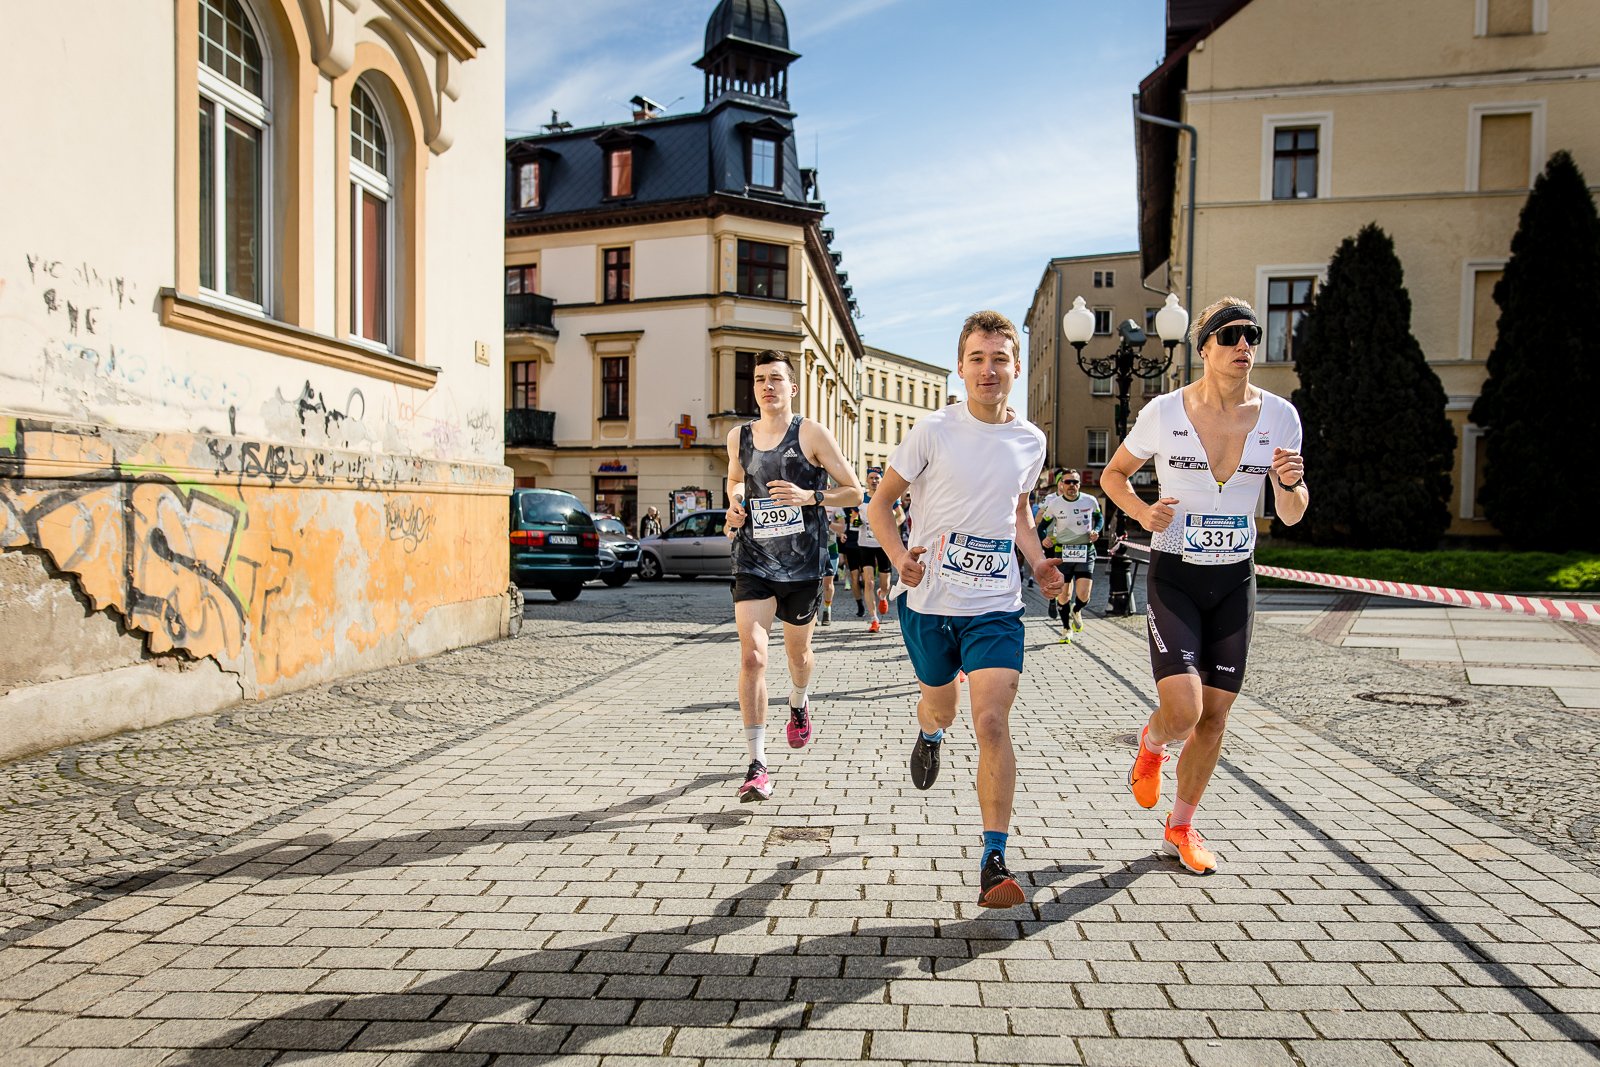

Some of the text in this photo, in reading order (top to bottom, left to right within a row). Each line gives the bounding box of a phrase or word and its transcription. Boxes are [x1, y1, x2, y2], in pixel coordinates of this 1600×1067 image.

[761, 510, 787, 523] 299
[1202, 531, 1234, 547] 331
[961, 551, 994, 571] 578
